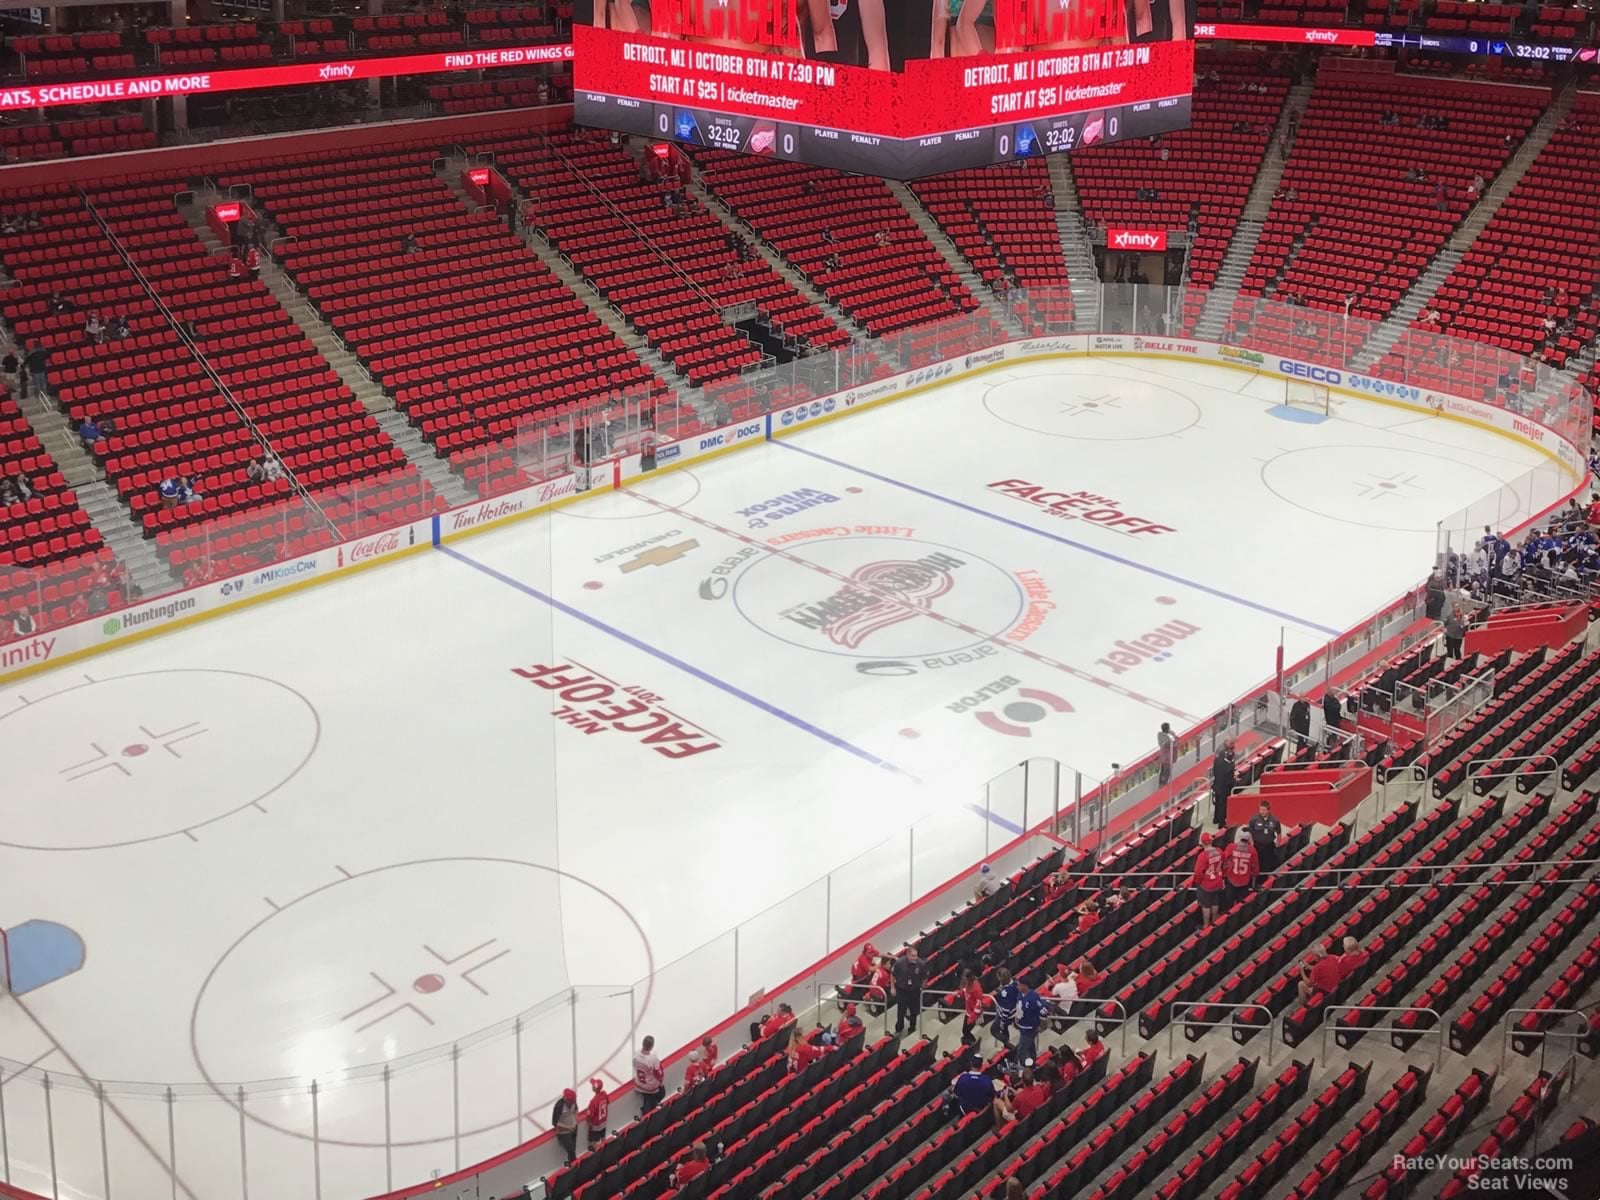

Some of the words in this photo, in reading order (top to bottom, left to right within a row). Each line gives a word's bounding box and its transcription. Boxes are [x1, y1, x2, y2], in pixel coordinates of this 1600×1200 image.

[1305, 30, 1338, 42] xfinity
[1470, 42, 1478, 52] 0
[1516, 45, 1550, 59] 32:02
[1552, 46, 1573, 54] PERIOD
[445, 53, 474, 67] FIND
[476, 51, 498, 64] THE
[500, 49, 523, 62] RED
[526, 48, 562, 60] WINGS
[623, 43, 669, 67] DETROIT,
[671, 50, 685, 67] MI
[696, 51, 743, 75] OCTOBER
[746, 58, 768, 78] 8TH
[770, 61, 785, 80] AT
[787, 62, 812, 84] 7:30
[815, 66, 835, 87] PM
[1555, 54, 1567, 62] 1ST
[319, 64, 354, 79] xfinity
[964, 64, 1011, 88] DETROIT,
[1014, 63, 1028, 82] MI
[1038, 55, 1080, 79] OCTOBER
[1082, 53, 1100, 72] 8TH
[1102, 52, 1113, 68] AT
[1115, 50, 1133, 67] 7:30
[1136, 48, 1150, 65] PM
[39, 82, 124, 102] SCHEDULE
[128, 79, 162, 95] AND
[165, 76, 210, 91] MORE
[650, 74, 680, 95] START
[682, 78, 696, 97] AT
[698, 80, 718, 100] $25
[728, 87, 798, 110] ticketmaster
[991, 95, 1021, 114] START
[1023, 91, 1036, 109] AT
[1038, 89, 1057, 108] $25
[1065, 83, 1123, 102] ticketmaster
[587, 94, 606, 103] PLAYER
[617, 98, 640, 108] PENALTY
[1133, 103, 1150, 112] PLAYER
[1158, 98, 1178, 108] PENALTY
[660, 113, 668, 132] 0
[715, 117, 732, 126] SHOTS
[1109, 117, 1118, 136] 0
[708, 125, 740, 144] 32:02
[784, 134, 794, 154] 0
[815, 129, 838, 139] PLAYER
[851, 134, 880, 146] PENALTY
[920, 136, 941, 147] PLAYER
[955, 130, 980, 141] PENALTY
[1046, 128, 1074, 146] 32:02
[1000, 135, 1009, 155] 0
[1114, 232, 1159, 248] xfinity
[1144, 342, 1173, 351] BELLE
[1177, 344, 1198, 354] TIRE
[1279, 360, 1342, 385] GEICO
[700, 435, 723, 450] DMC
[737, 424, 760, 438] DOCS
[1513, 418, 1545, 441] meijer
[735, 487, 822, 518] Wilcox
[765, 492, 840, 521] Burns
[986, 479, 1178, 535] FACE-OFF
[1071, 490, 1121, 508] NHL
[452, 510, 475, 530] Tim
[477, 500, 523, 523] Hortons
[1042, 508, 1079, 520] 2017
[767, 527, 851, 547] Caesars
[855, 525, 915, 538] Little
[593, 529, 682, 564] CHEVROLET
[719, 547, 760, 576] arena
[1014, 569, 1053, 601] Little
[122, 597, 196, 628] Huntington
[1006, 600, 1057, 642] Caesars
[922, 643, 999, 670] arena
[1094, 618, 1202, 676] meijer
[622, 685, 664, 704] 2017
[945, 675, 1022, 714] BELFOR
[510, 664, 722, 759] FACE-OFF
[550, 705, 609, 735] NHL
[1233, 858, 1250, 875] 15
